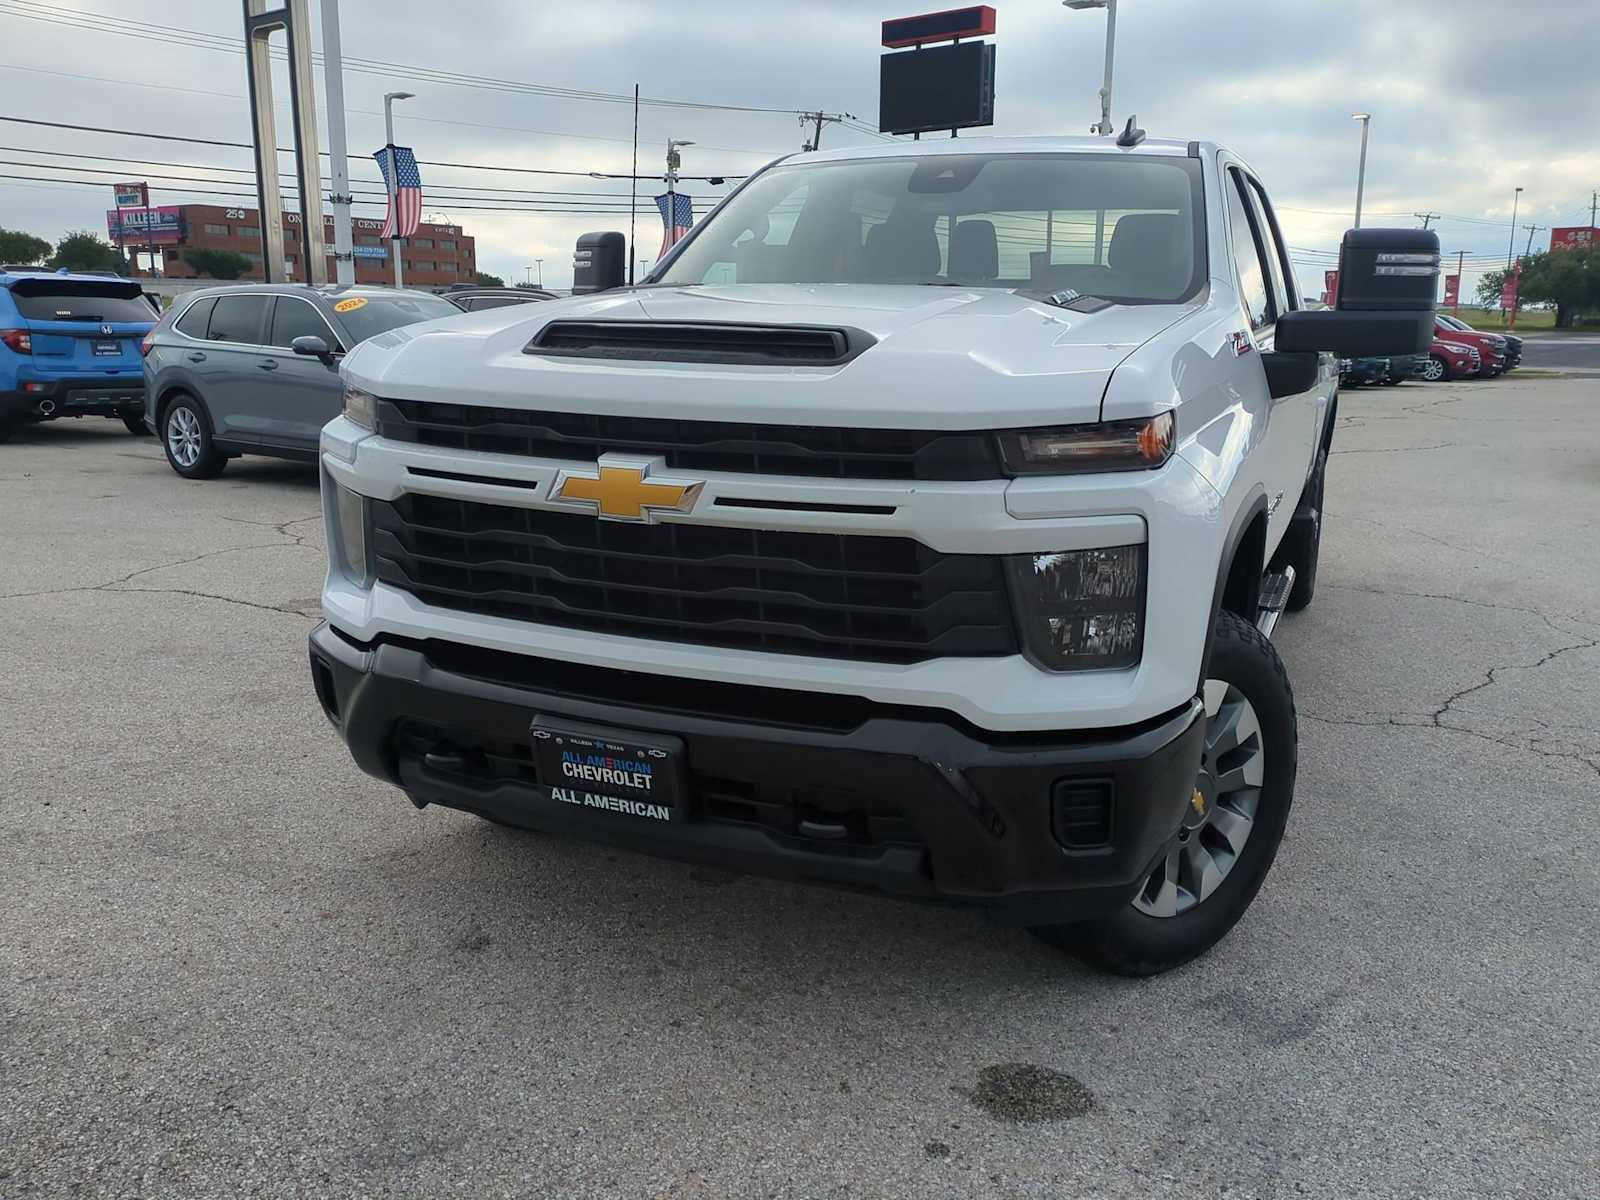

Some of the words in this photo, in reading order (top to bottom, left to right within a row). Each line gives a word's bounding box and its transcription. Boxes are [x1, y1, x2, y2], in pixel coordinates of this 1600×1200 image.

[562, 751, 585, 764] ALL
[587, 755, 652, 775] AMERICAN
[562, 761, 652, 790] CHEVROLET
[551, 787, 581, 806] ALL
[584, 793, 671, 822] AMERICAN
